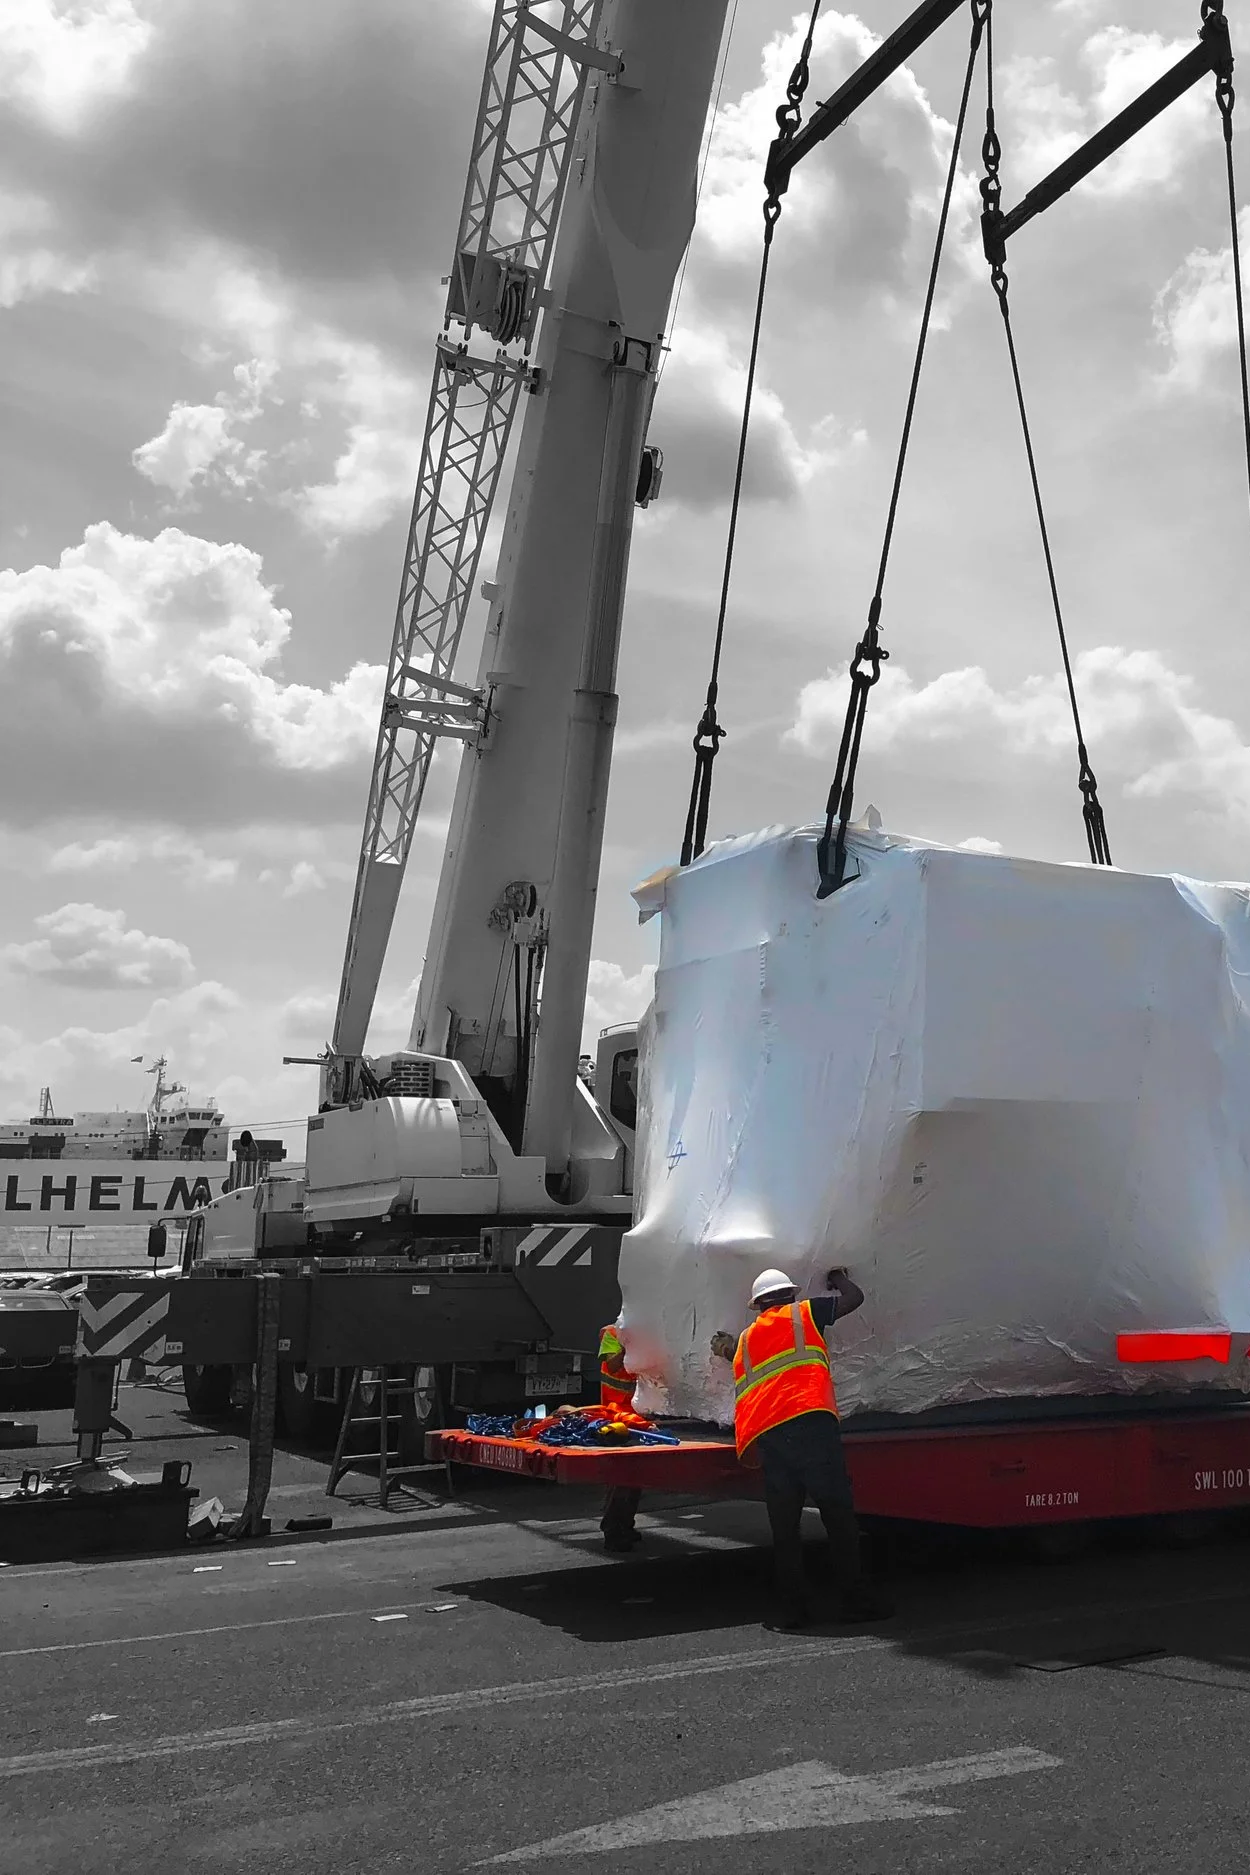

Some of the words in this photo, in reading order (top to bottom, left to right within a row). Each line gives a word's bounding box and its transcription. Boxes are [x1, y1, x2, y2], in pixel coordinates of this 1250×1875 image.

[1194, 1470, 1218, 1491] SWL
[1222, 1468, 1244, 1489] 100
[1025, 1493, 1046, 1507] TARE
[1047, 1492, 1061, 1506] 8.2
[1063, 1491, 1079, 1505] TON
